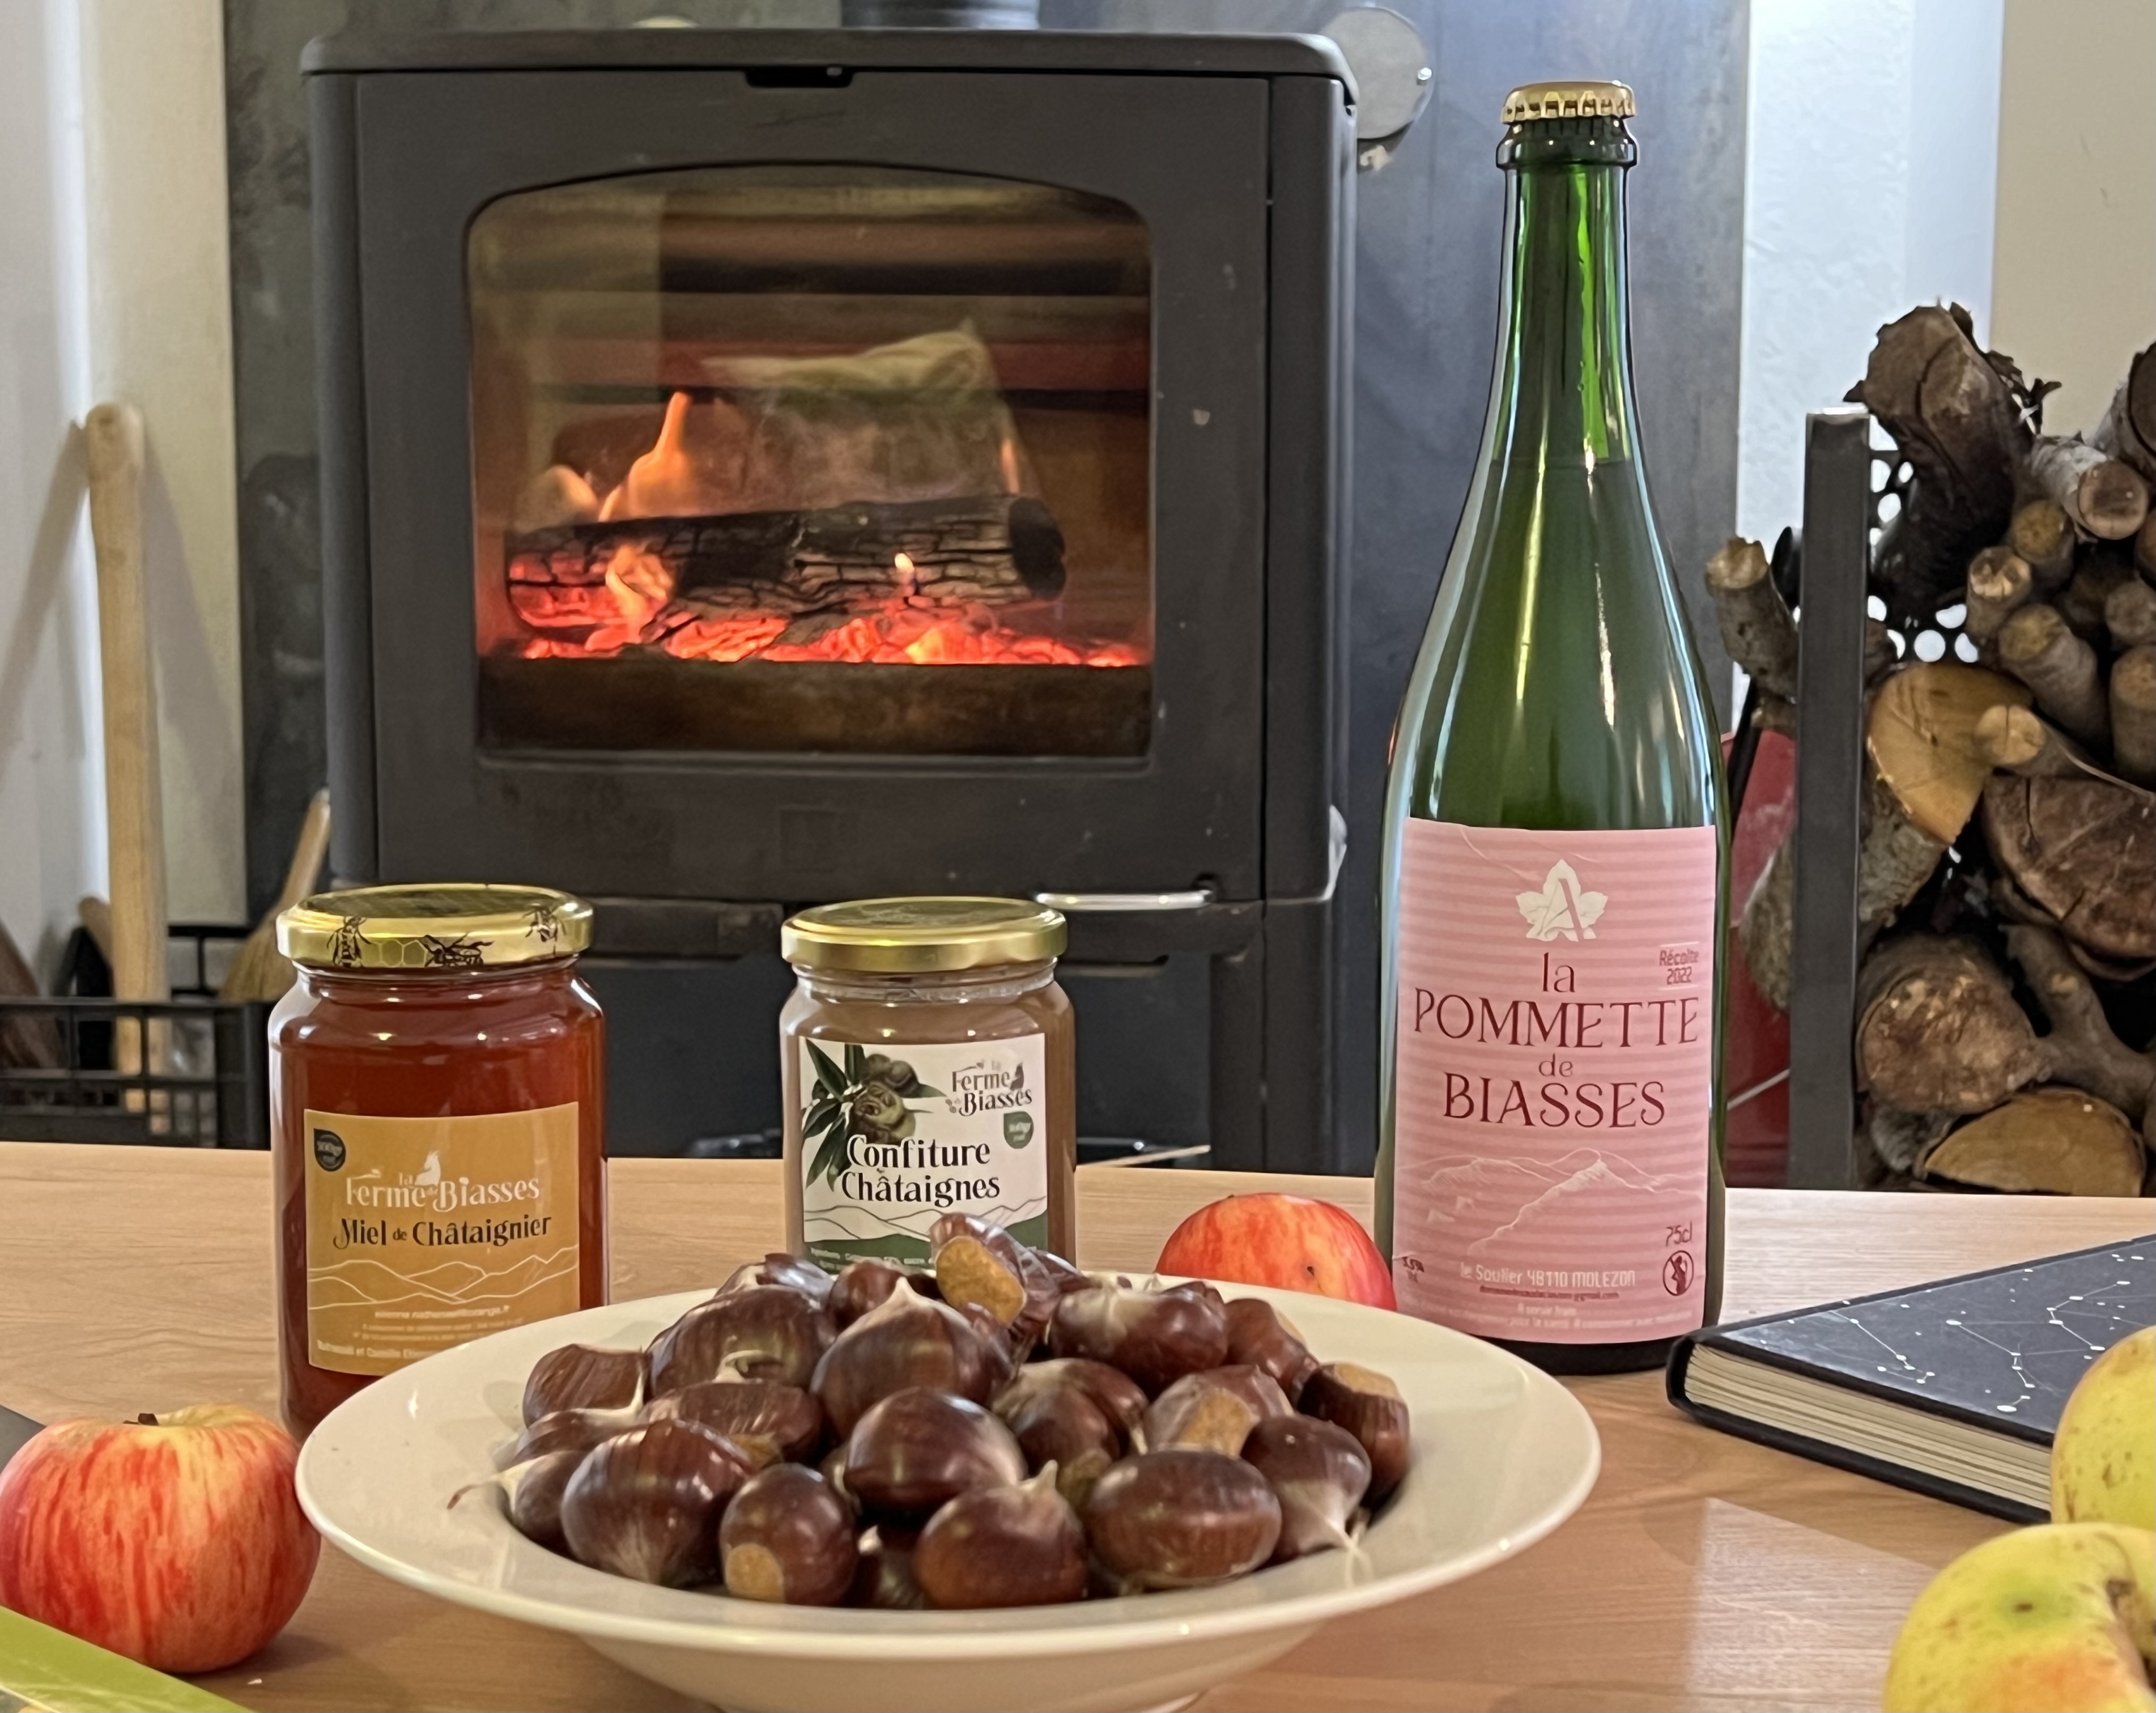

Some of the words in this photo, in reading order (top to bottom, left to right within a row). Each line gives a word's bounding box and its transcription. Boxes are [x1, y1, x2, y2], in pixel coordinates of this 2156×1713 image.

[1659, 948, 1699, 966] Récolte
[1542, 953, 1575, 993] la
[1667, 966, 1692, 985] 2022
[1414, 987, 1699, 1048] POMMETTE
[952, 1062, 1010, 1092] Ferme
[1538, 1053, 1574, 1077] de
[959, 1089, 1032, 1117] Biasses
[1443, 1072, 1665, 1128] BIASSES
[850, 1136, 990, 1168] Confiture
[346, 1169, 426, 1208] Ferme
[432, 1176, 540, 1213] Biasses
[841, 1171, 1000, 1208] Châtaignes
[333, 1218, 386, 1249] Miel
[392, 1228, 407, 1242] de
[412, 1214, 552, 1247] Châtaignier
[1665, 1221, 1693, 1247] 75cl
[1475, 1264, 1523, 1285] Soulier
[1527, 1269, 1568, 1286] 48110
